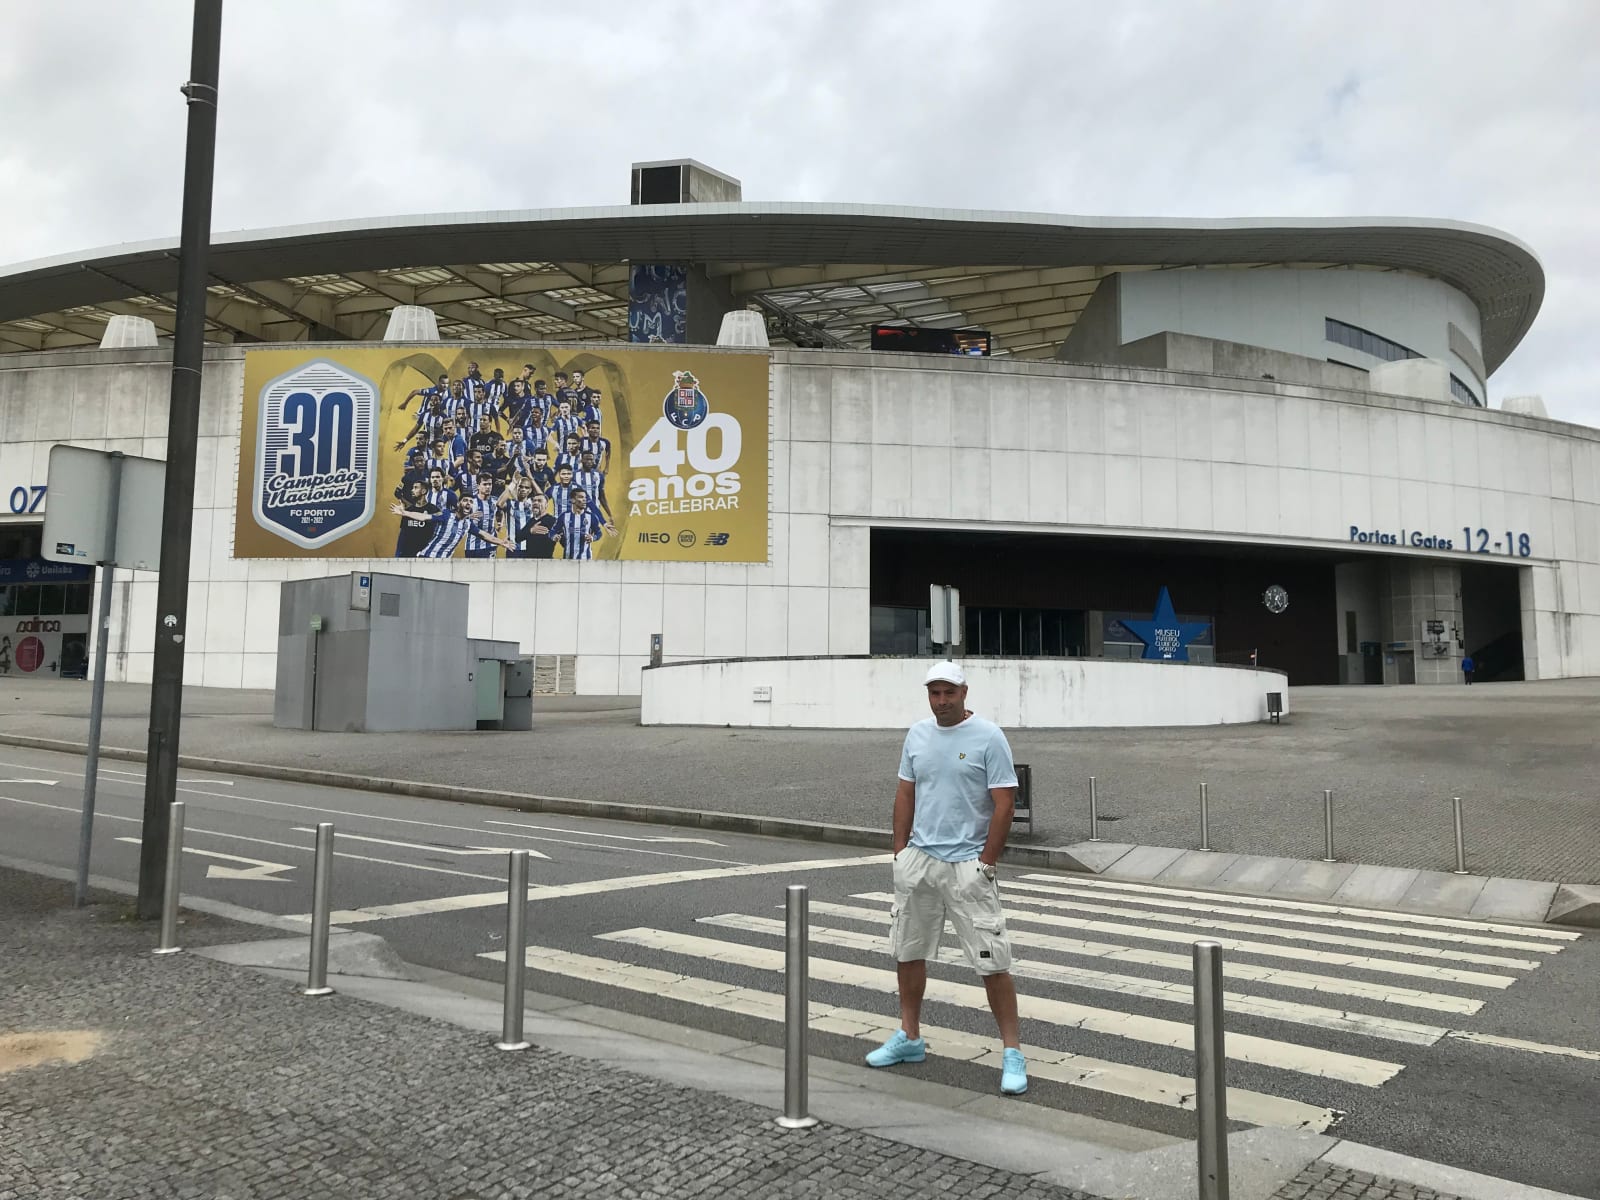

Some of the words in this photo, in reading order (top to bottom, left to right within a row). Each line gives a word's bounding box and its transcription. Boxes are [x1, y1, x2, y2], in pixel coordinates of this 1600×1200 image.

[281, 391, 354, 477] 30
[629, 412, 742, 476] 40
[267, 469, 361, 492] Campeão
[628, 471, 742, 502] anos
[268, 482, 356, 507] Nacional
[629, 504, 642, 517] A
[646, 495, 739, 516] CELEBRAR
[290, 509, 303, 517] FC
[304, 509, 336, 517] PORTO
[1350, 526, 1397, 545] Portas
[1410, 531, 1453, 550] Gates
[42, 565, 73, 575] Unilabs
[1154, 628, 1180, 637] MUSEU
